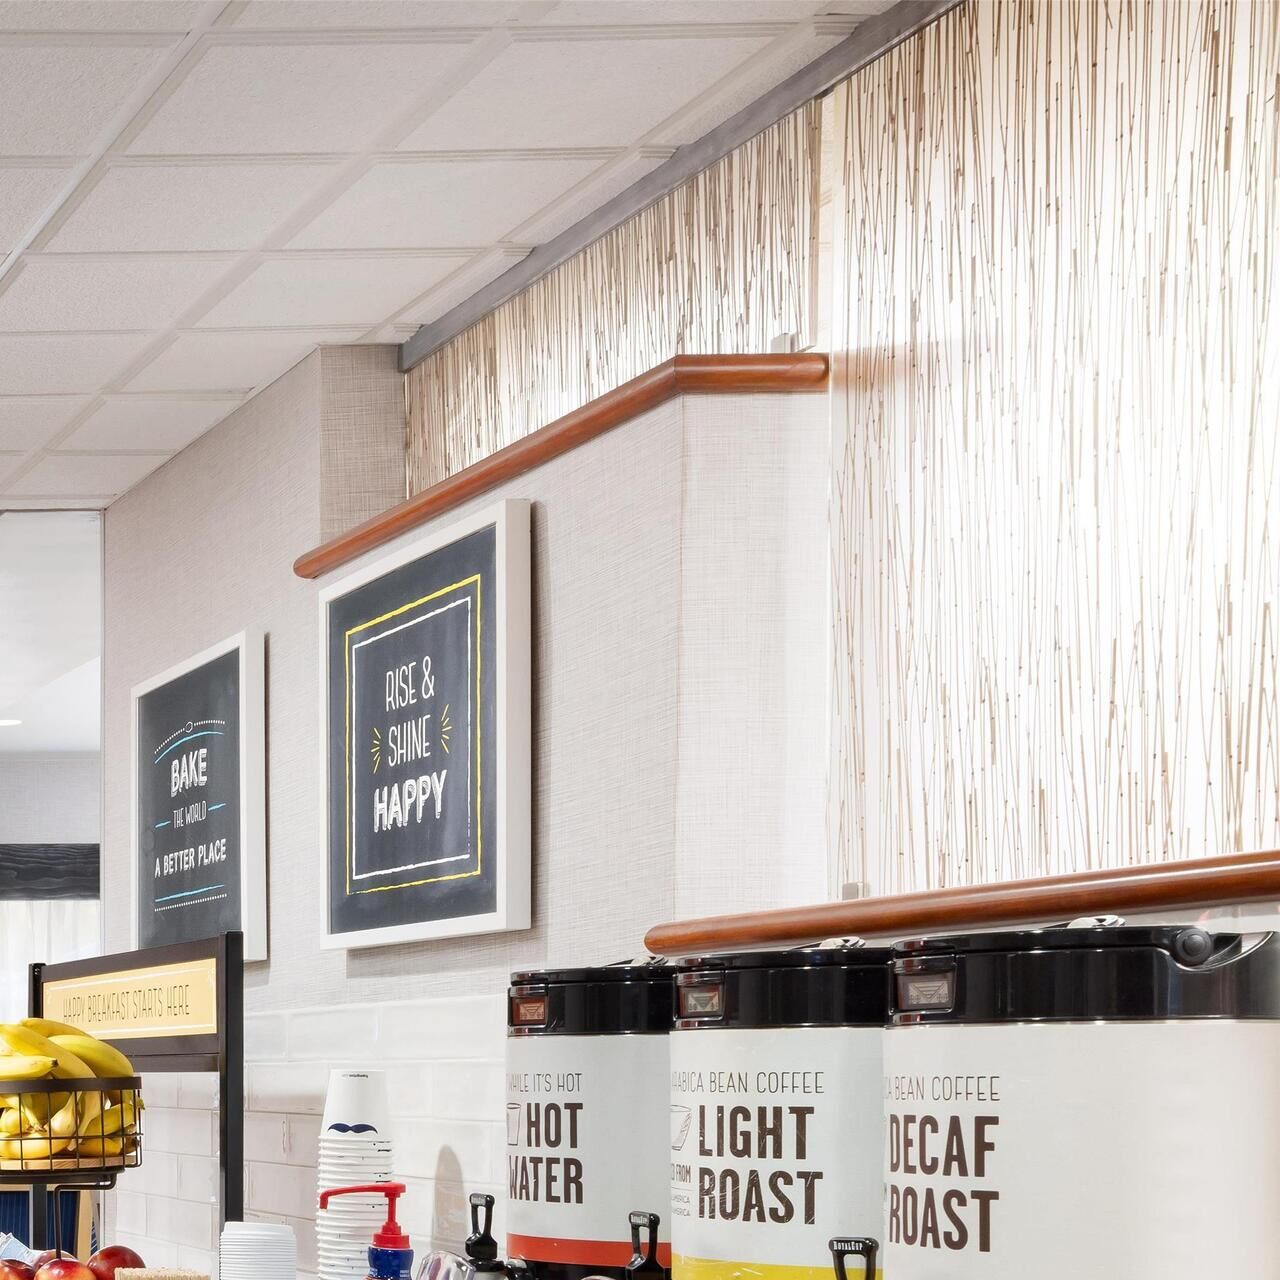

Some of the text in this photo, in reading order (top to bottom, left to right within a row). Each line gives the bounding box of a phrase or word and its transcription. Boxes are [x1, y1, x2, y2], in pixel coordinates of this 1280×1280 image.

[386, 656, 435, 712] RISE &
[388, 715, 431, 767] SHINE
[171, 748, 207, 798] BAKE
[173, 801, 207, 828] THE WORLD
[374, 769, 447, 832] HAPPY
[154, 838, 227, 879] A BETTER PLACE
[64, 984, 189, 1023] HAPPY BREAKFAST STARTS HERE
[534, 1073, 552, 1092] IT'S
[557, 1073, 582, 1092] HOT
[710, 1072, 747, 1093] BEAN
[757, 1072, 824, 1093] COFFEE
[895, 1076, 925, 1100] BEAN
[932, 1076, 1000, 1101] COFFEE
[527, 1103, 583, 1148] HOT
[699, 1105, 814, 1159] LIGHT
[889, 1114, 999, 1177] DECAF
[509, 1155, 583, 1204] WATER
[699, 1167, 823, 1224] ROAST
[889, 1185, 999, 1252] ROAST
